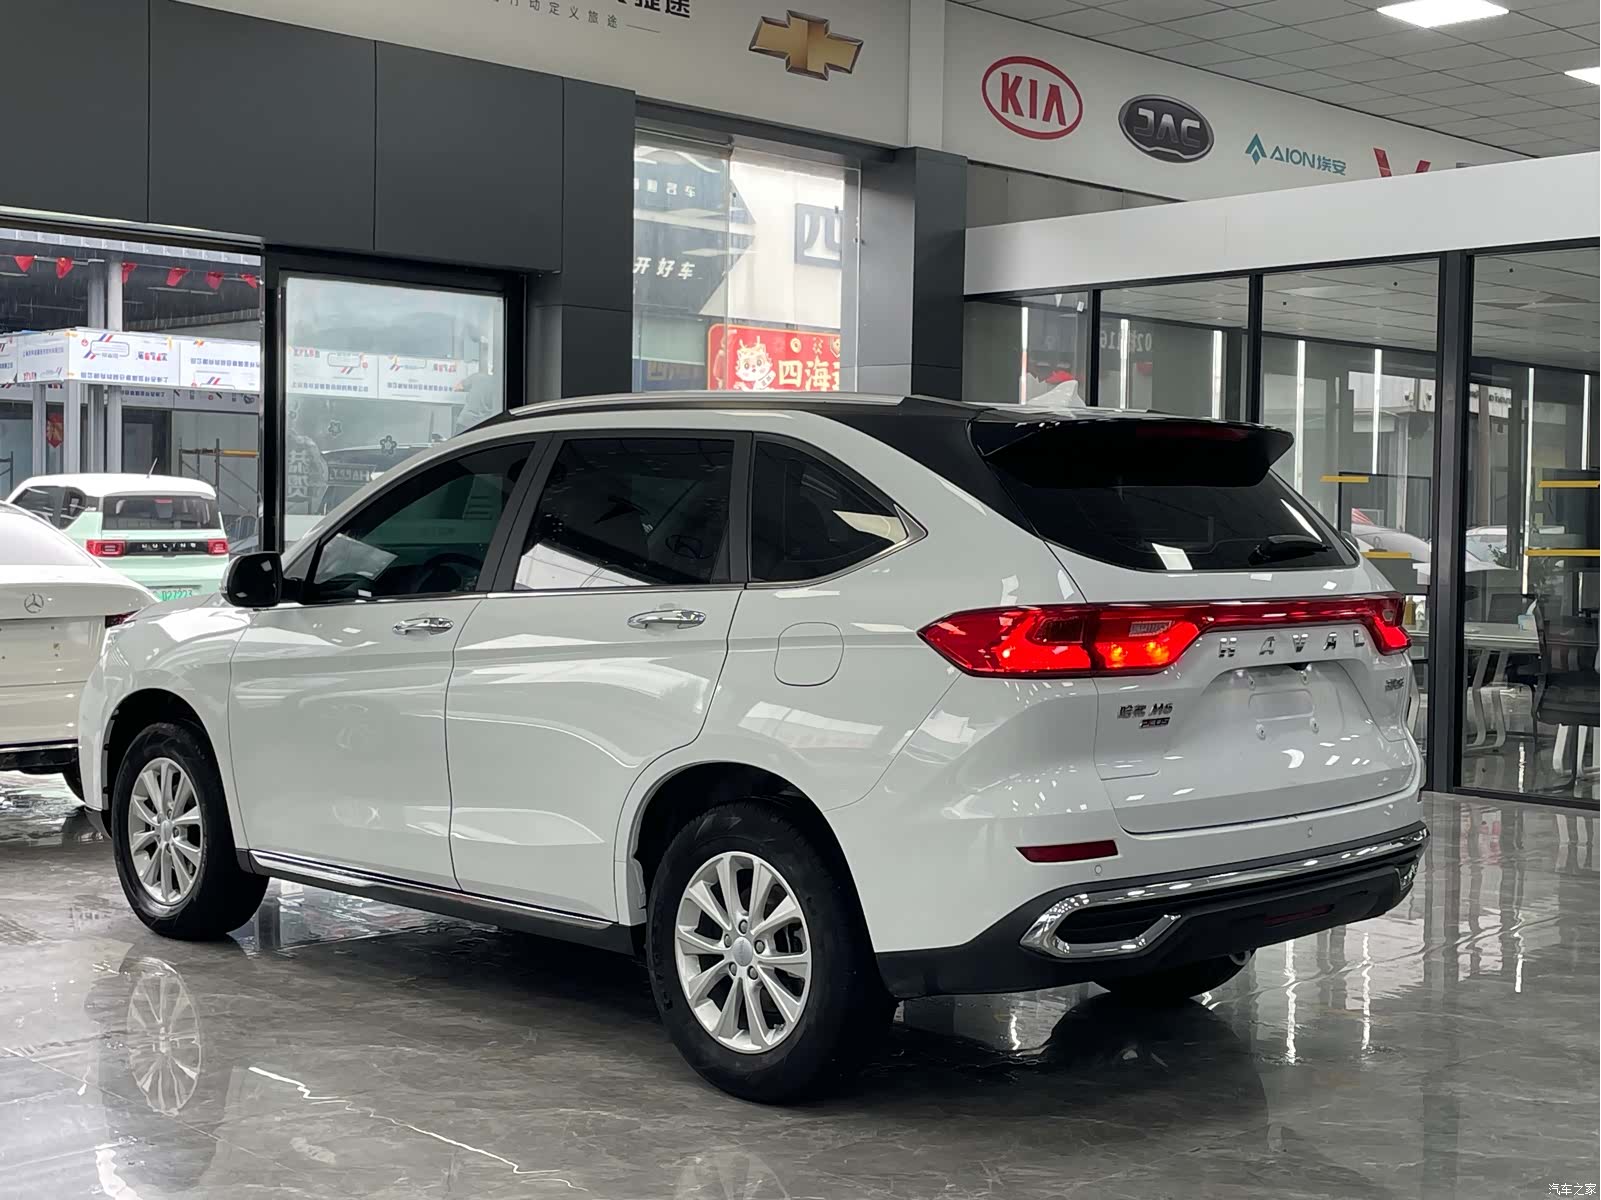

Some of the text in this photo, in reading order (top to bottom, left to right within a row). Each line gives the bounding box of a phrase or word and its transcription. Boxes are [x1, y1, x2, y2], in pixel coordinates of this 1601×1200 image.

[495, 0, 618, 29] 动定义旅途
[1000, 72, 1067, 127] KIA
[1133, 107, 1202, 147] JAC
[1218, 629, 1366, 658] HAVAL
